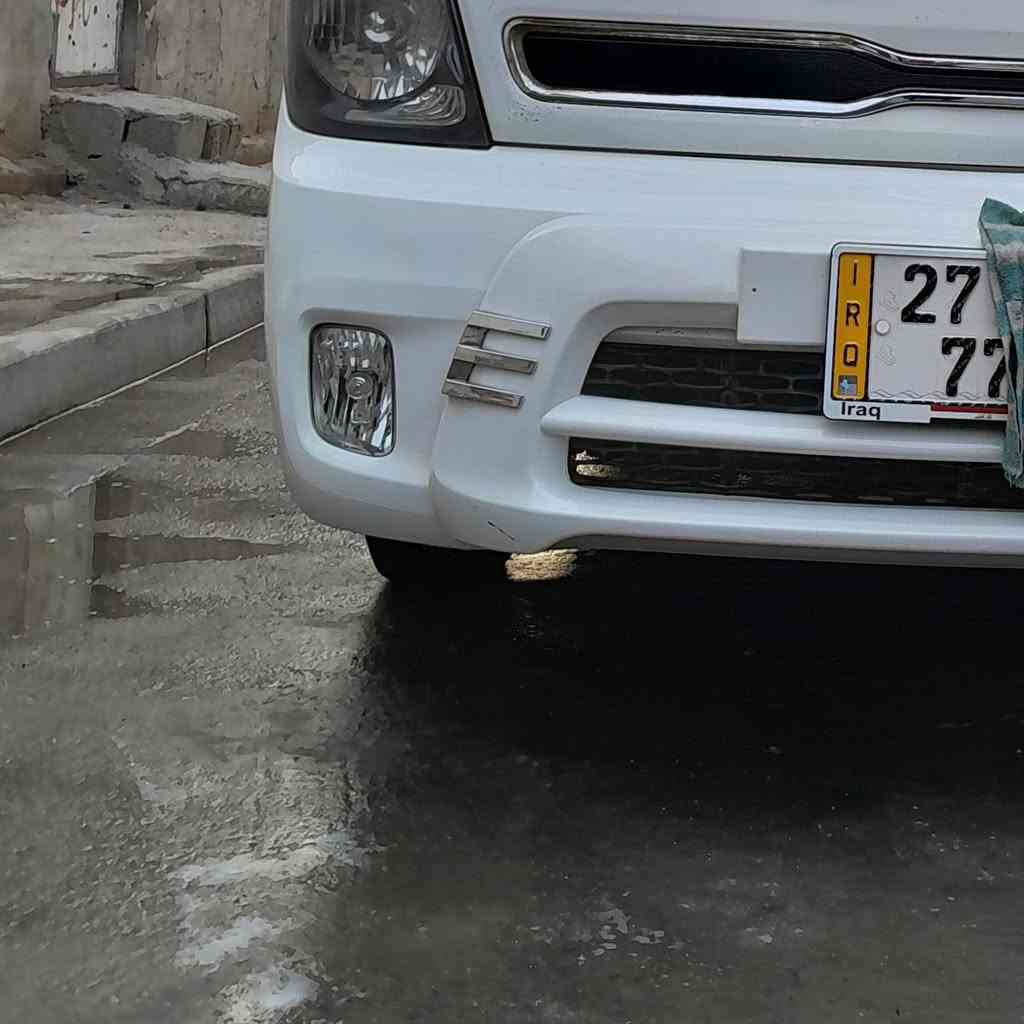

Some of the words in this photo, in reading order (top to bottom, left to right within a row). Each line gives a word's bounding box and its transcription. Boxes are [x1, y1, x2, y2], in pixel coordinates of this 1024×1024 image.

[842, 262, 861, 367] IRQ
[901, 264, 981, 324] 27
[840, 402, 881, 420] Iraq
